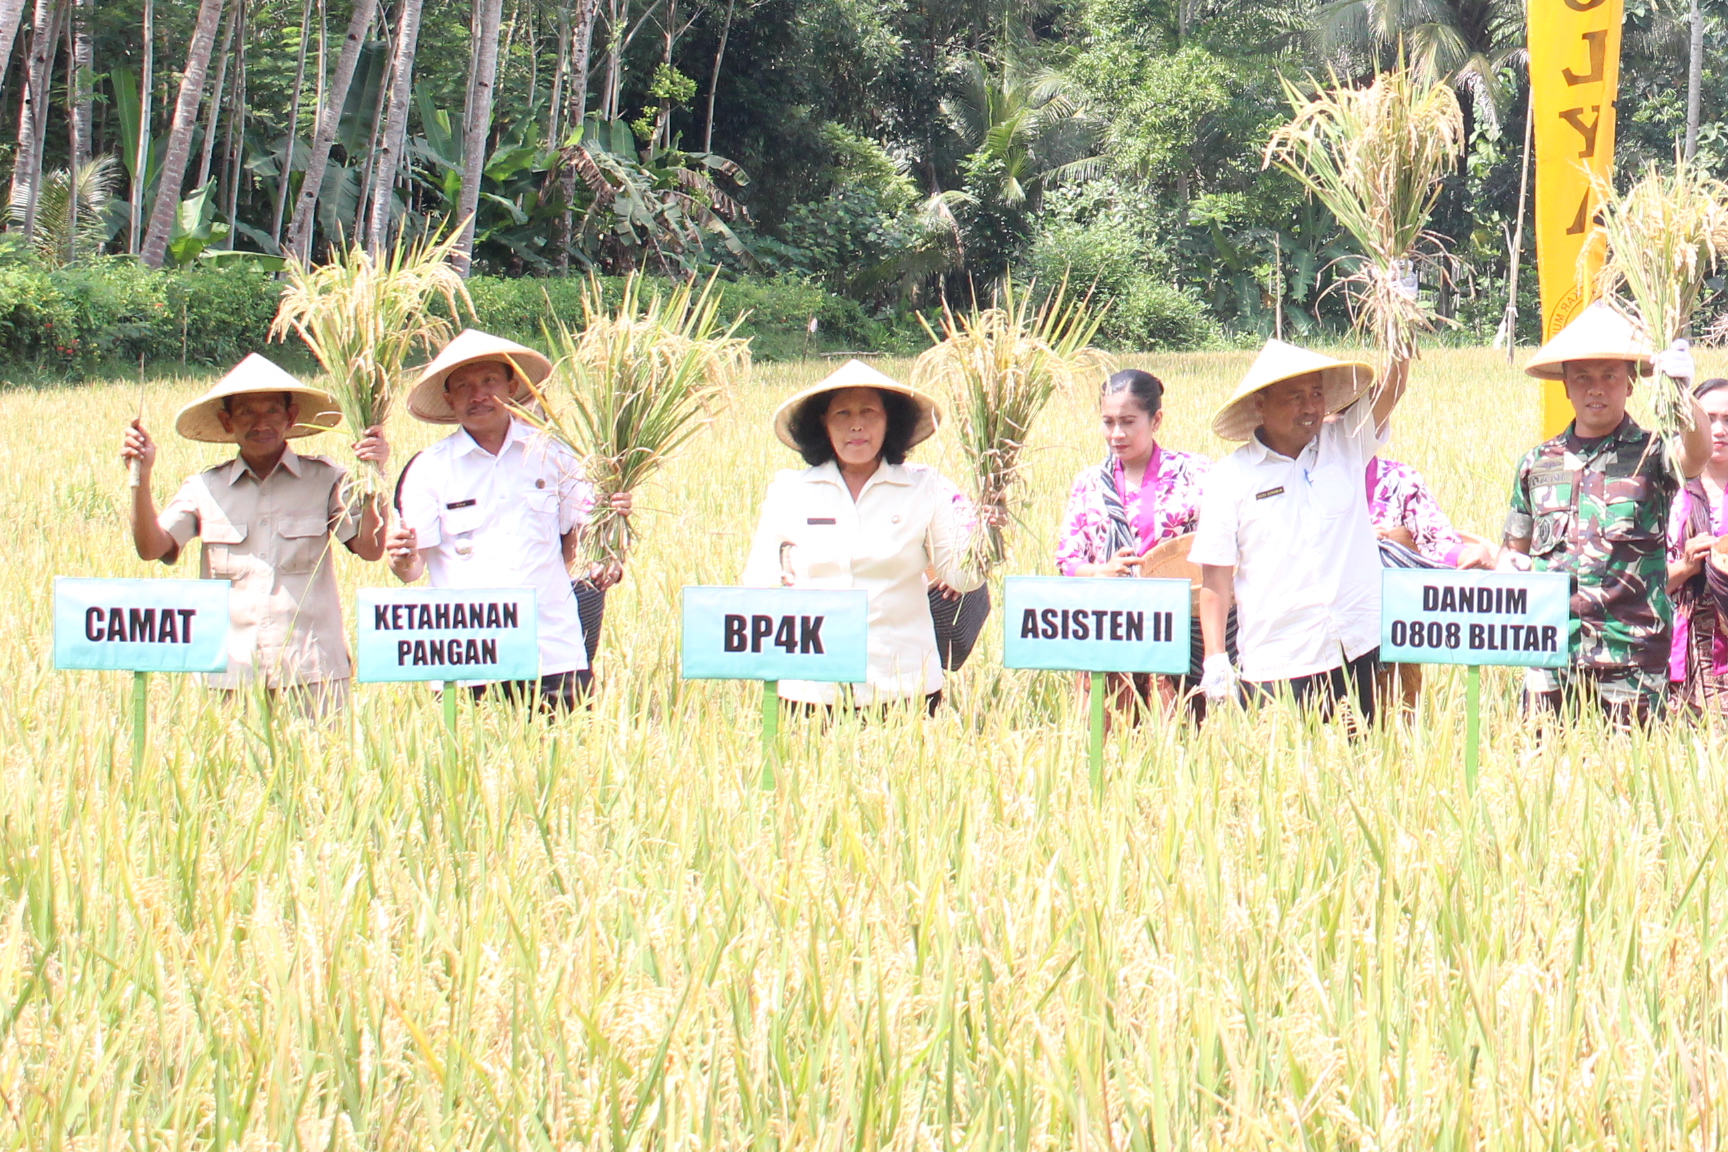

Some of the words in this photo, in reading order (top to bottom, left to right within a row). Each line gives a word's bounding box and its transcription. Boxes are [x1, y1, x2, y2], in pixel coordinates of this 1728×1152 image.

[374, 602, 518, 630] KETAHANAN
[1423, 585, 1527, 614] DANDIM
[85, 606, 197, 643] CAMAT
[724, 614, 825, 654] BP4K
[1020, 608, 1144, 641] ASISTEN
[1153, 611, 1172, 642] II
[1391, 619, 1461, 650] 0808
[1469, 623, 1558, 652] BLITAR
[398, 638, 498, 666] PANGAN
